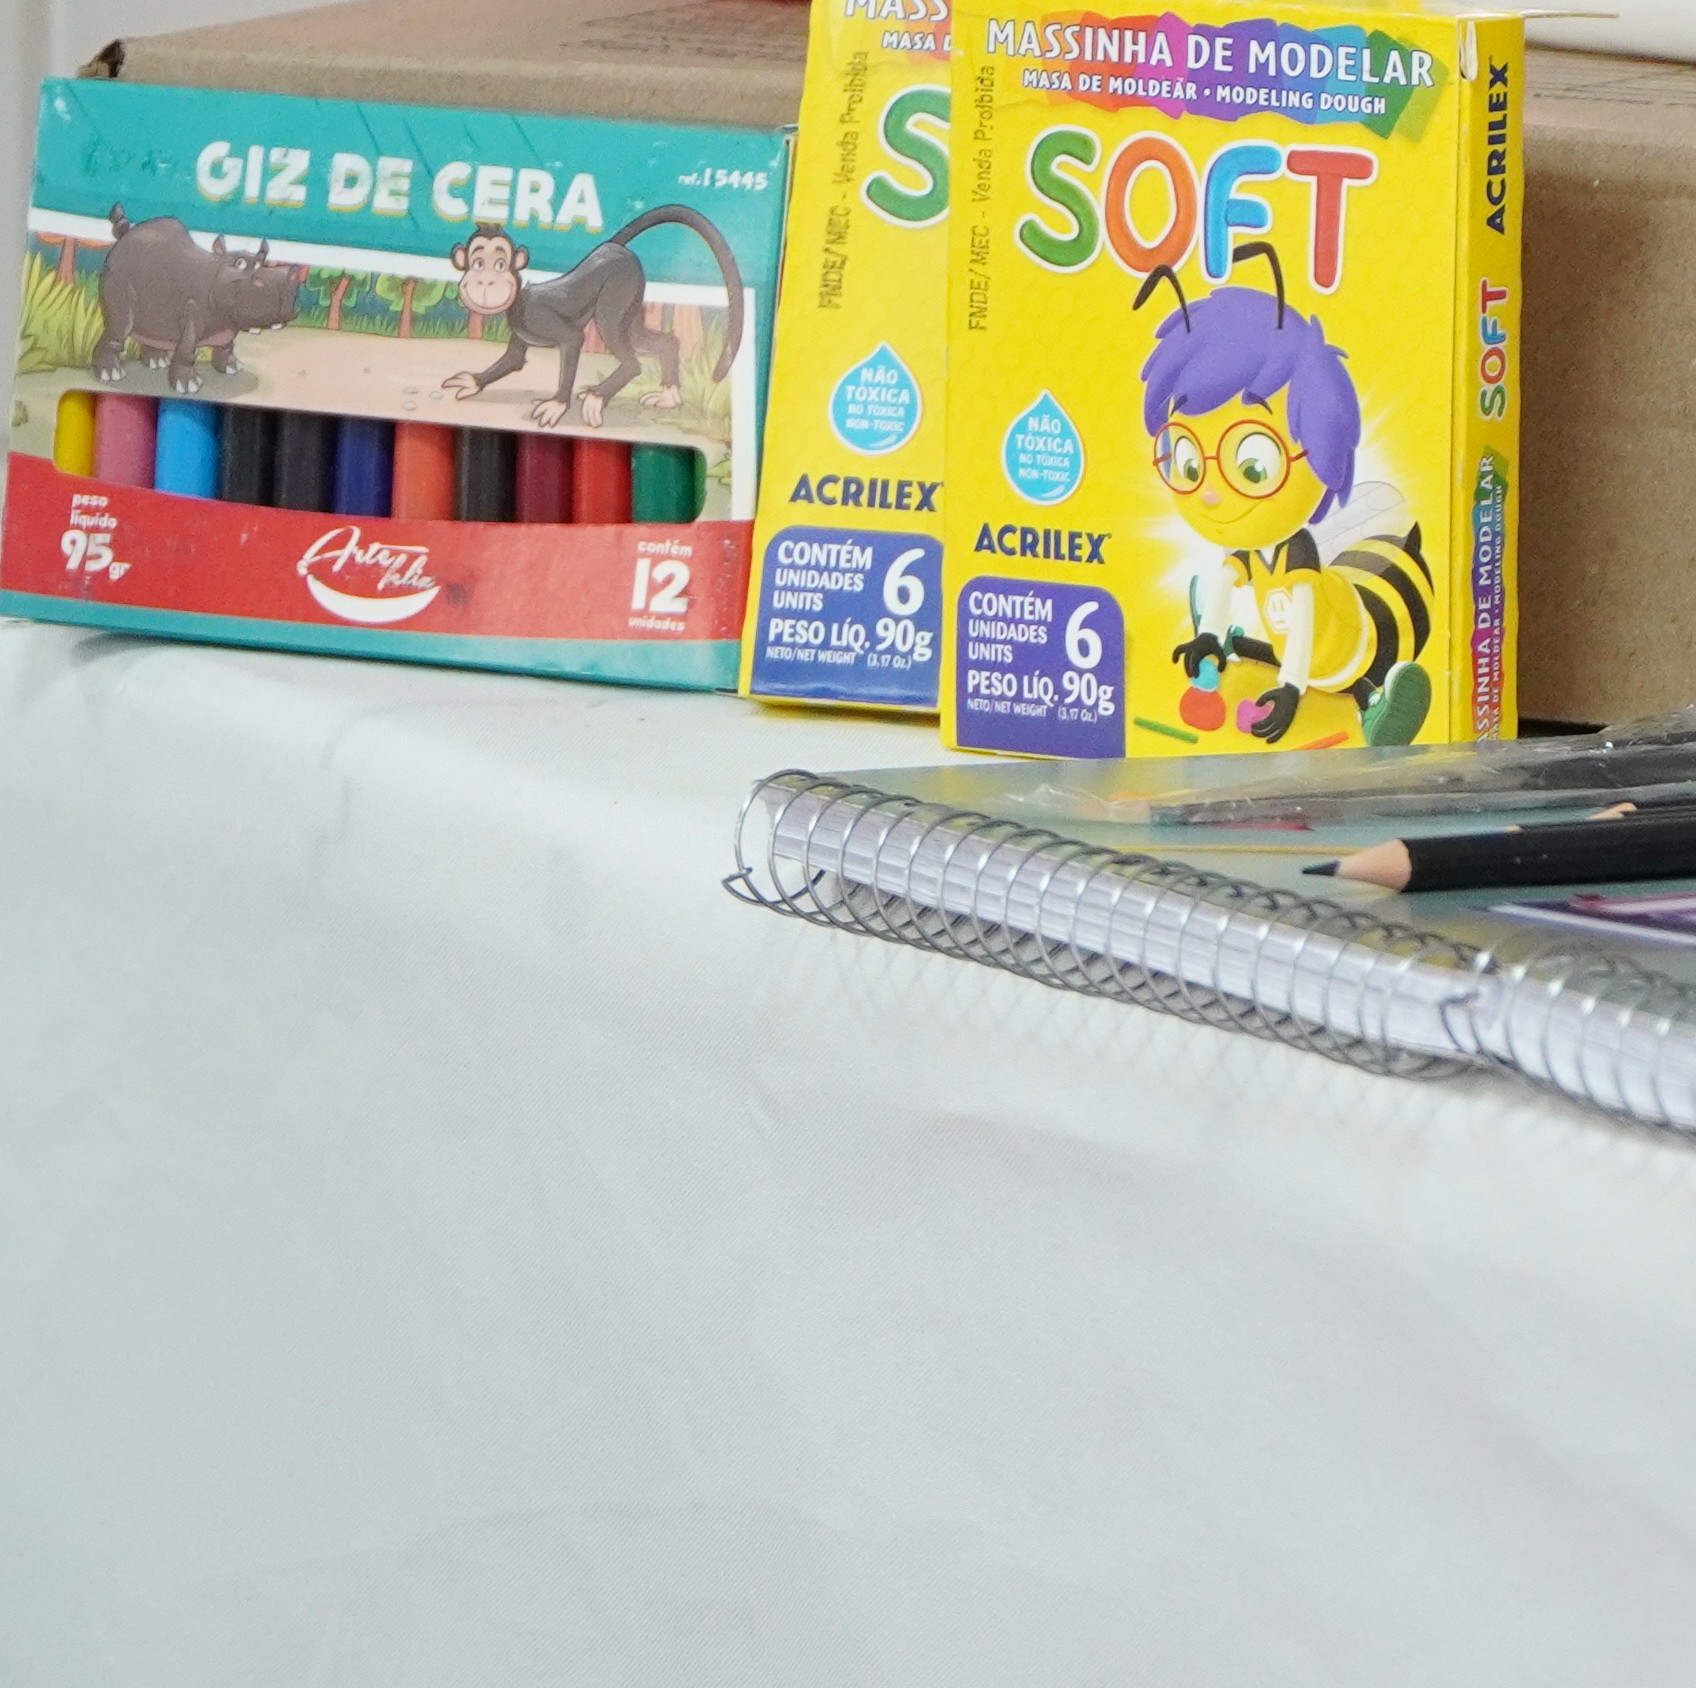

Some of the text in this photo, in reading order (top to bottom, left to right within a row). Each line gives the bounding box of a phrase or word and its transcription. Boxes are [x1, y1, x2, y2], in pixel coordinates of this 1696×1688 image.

[882, 30, 937, 53] MASA
[987, 18, 1436, 88] MASSINHA DE MODELAR
[1022, 68, 1388, 116] MASA DE MODELING DOUGH
[1485, 62, 1510, 235] ACRILEX
[196, 140, 605, 232] GIZ DE CERA
[970, 145, 994, 267] MEC Venda
[1017, 128, 1379, 297] SOFT
[1480, 277, 1510, 420] SOFT
[860, 364, 898, 385] NÃO
[845, 384, 910, 404] TÓXICA
[1027, 414, 1063, 434] NÃO
[1015, 432, 1075, 454] TÓXICA
[71, 492, 109, 511] peso
[789, 473, 938, 513] ACRILEX
[70, 509, 118, 530] líquido
[297, 525, 430, 575] Arte
[637, 539, 694, 559] contém
[777, 539, 873, 570] CONTÉM
[973, 523, 1106, 565] ACRILEX
[1477, 452, 1495, 631] DE MODELAR
[630, 556, 690, 613] 12
[775, 569, 865, 592] UNIDADES
[882, 547, 926, 617] 6
[772, 591, 824, 611] UNITS
[968, 591, 1053, 623] CONTÉM
[627, 614, 687, 633] unidades
[768, 617, 934, 662] PESO LÍQ. 90g
[968, 620, 1048, 645] UNIDADES
[1065, 600, 1103, 669] 6
[816, 649, 856, 665] WEIGHT
[967, 643, 1014, 664] UNITS
[967, 669, 1116, 716] PESO LÍQ. 90g
[1012, 701, 1047, 718] WEIGHT
